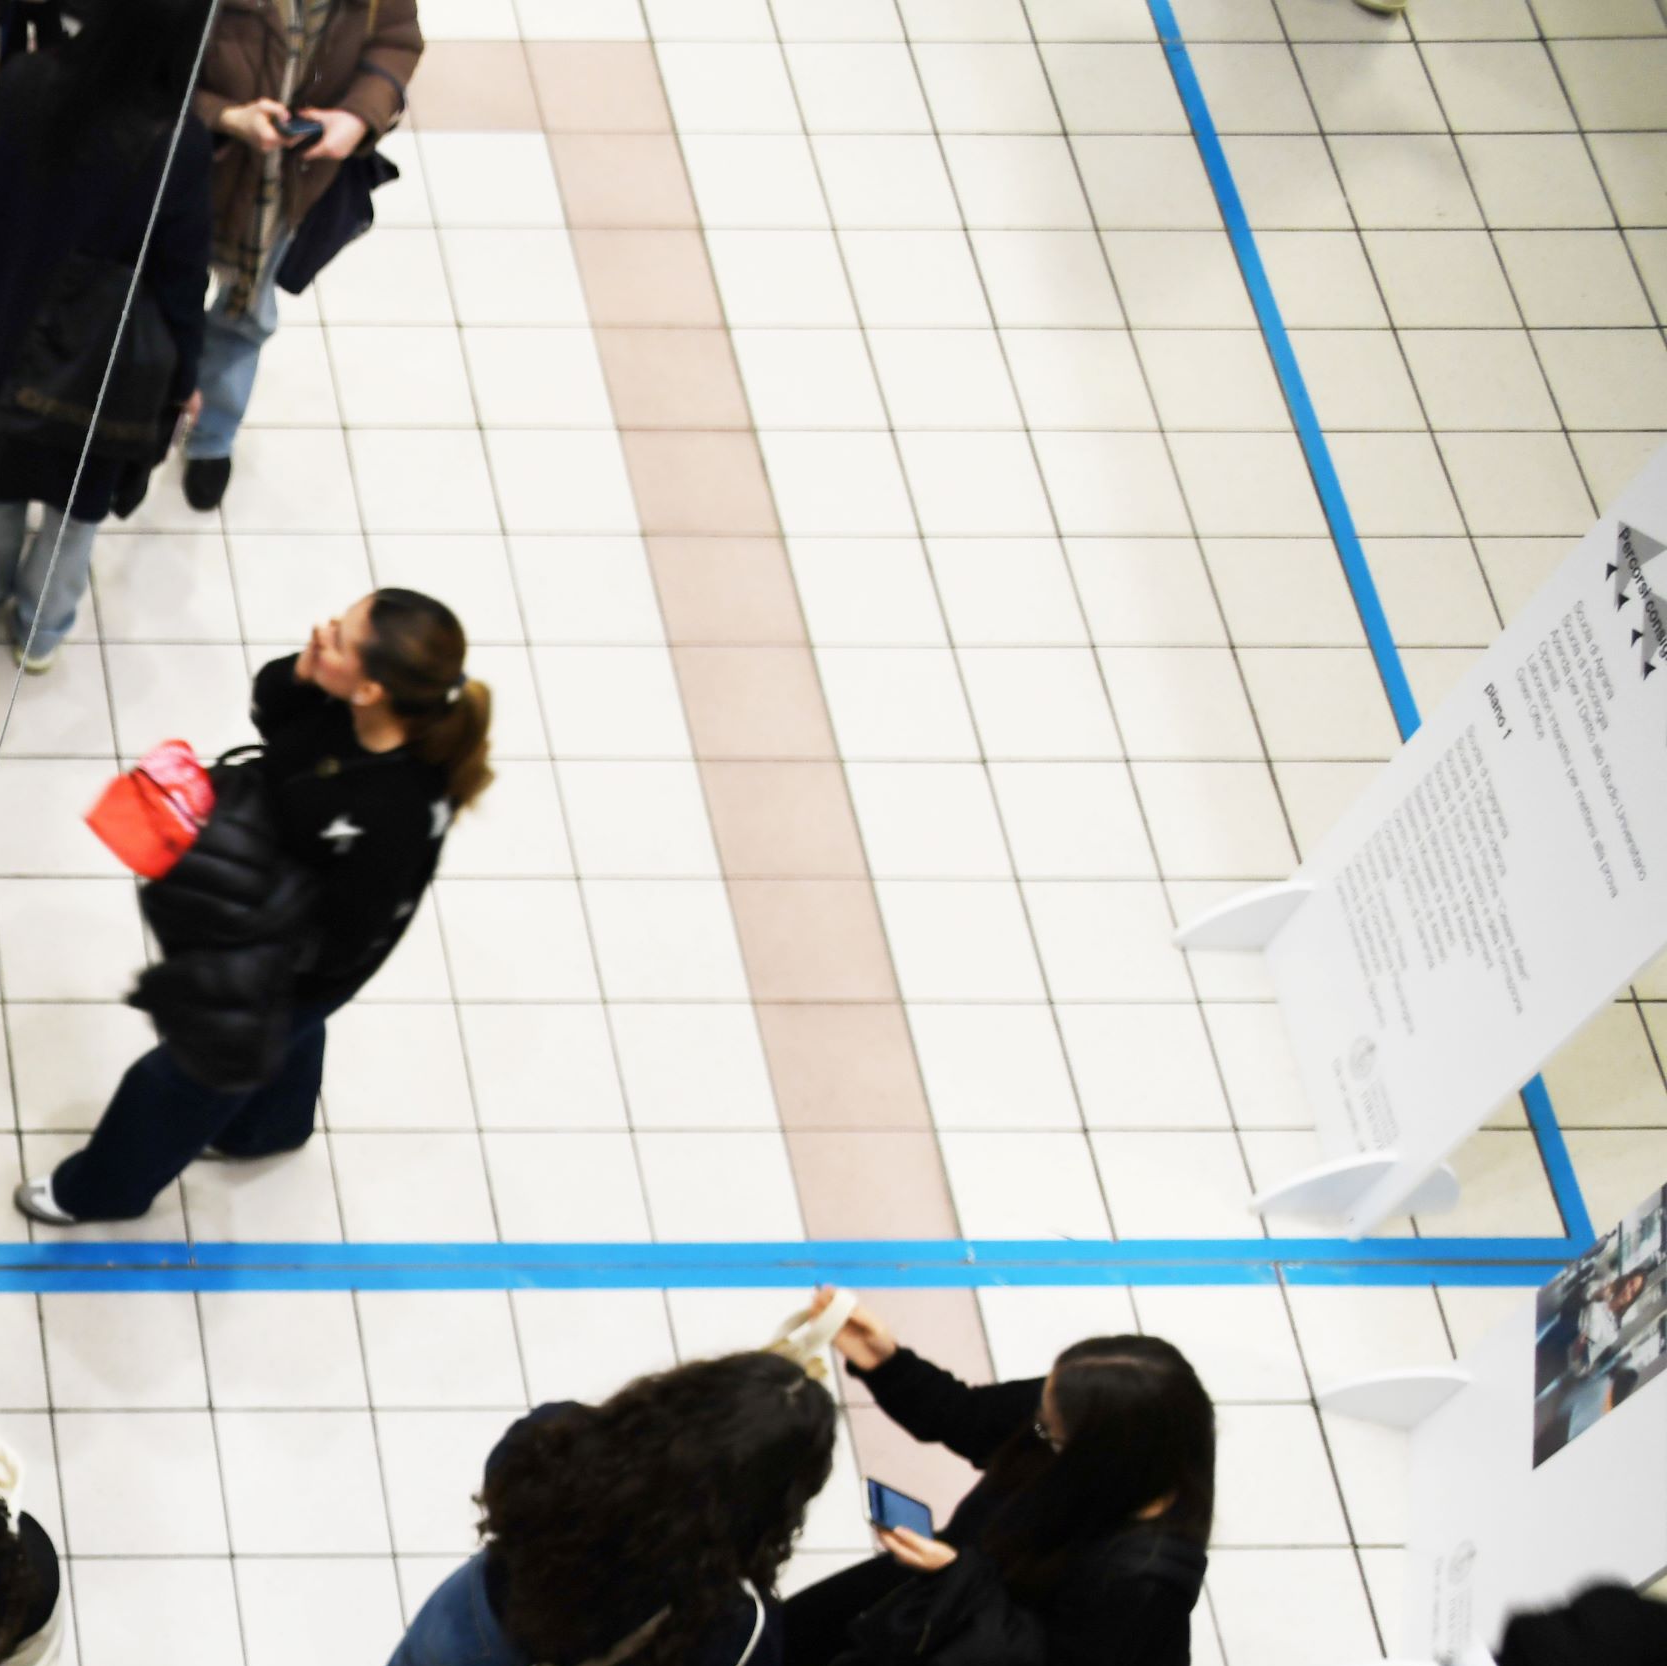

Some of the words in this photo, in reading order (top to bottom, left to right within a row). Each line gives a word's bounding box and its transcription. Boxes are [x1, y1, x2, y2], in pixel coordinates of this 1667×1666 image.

[1618, 527, 1652, 600] Percorsi
[1645, 600, 1667, 661] consig
[1484, 683, 1506, 728] piano
[1502, 727, 1513, 740] 1
